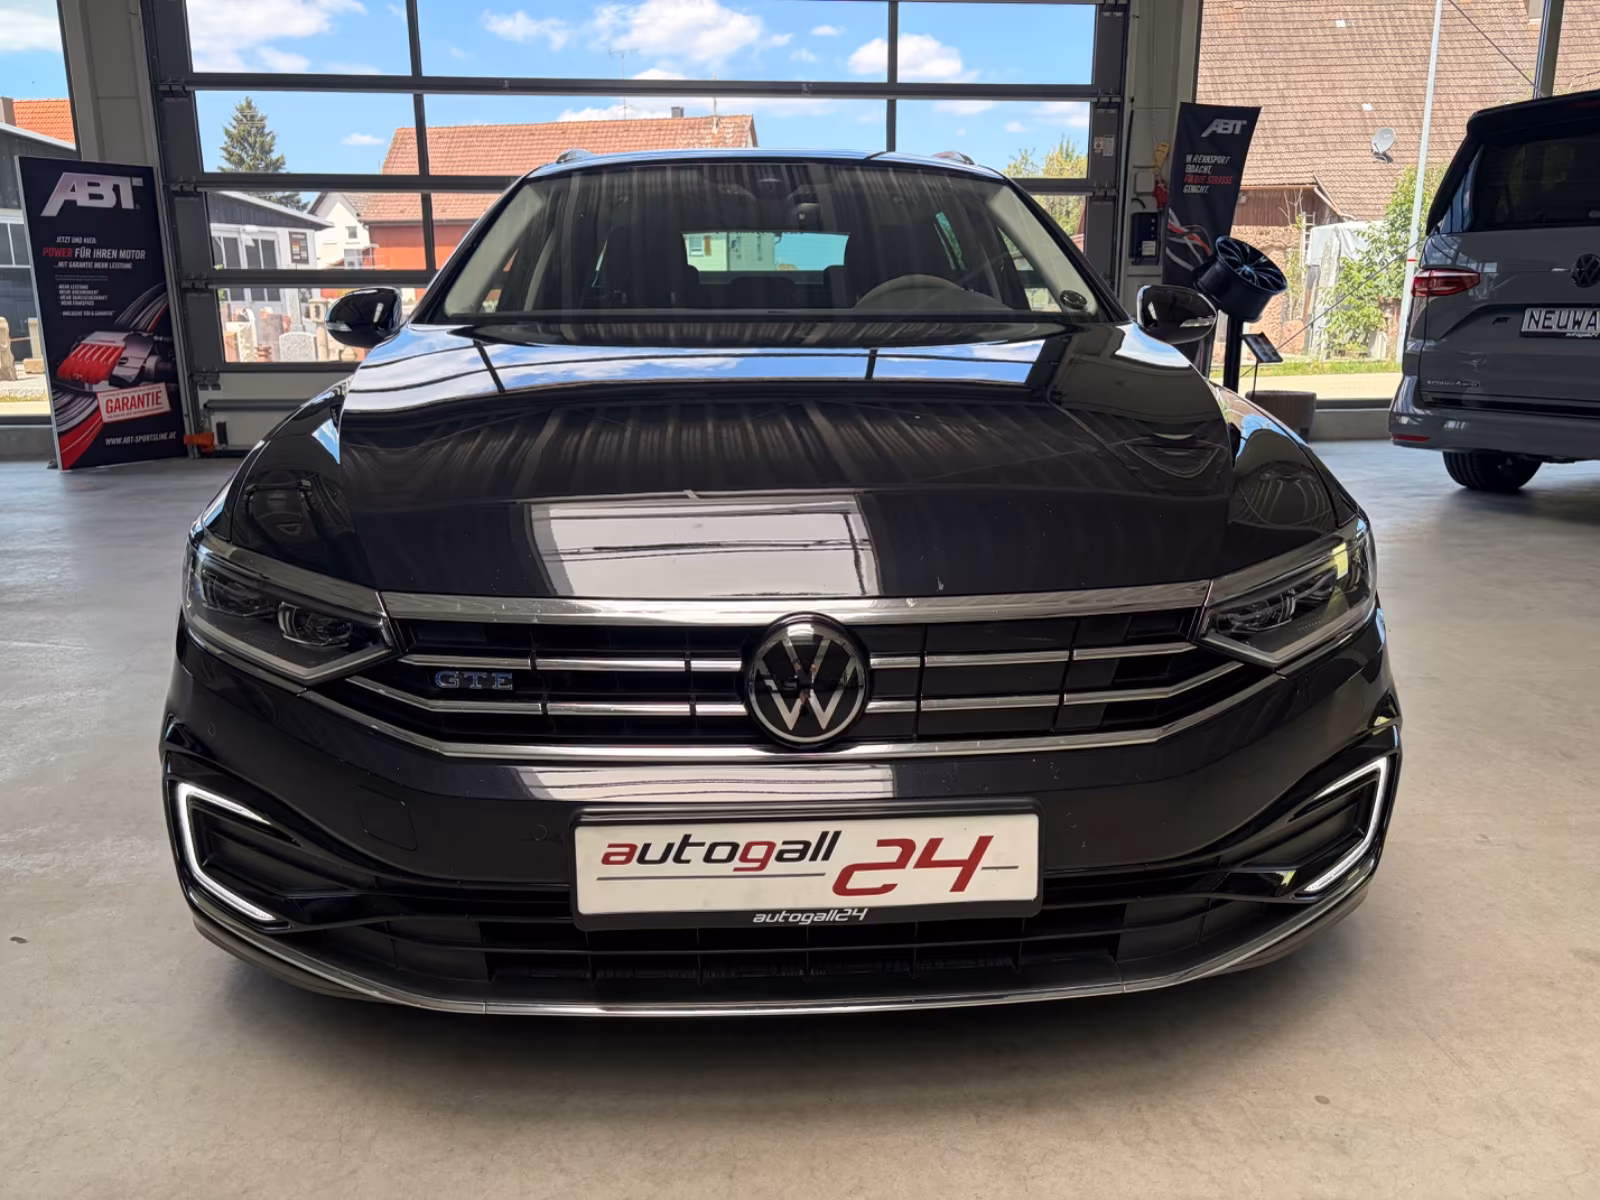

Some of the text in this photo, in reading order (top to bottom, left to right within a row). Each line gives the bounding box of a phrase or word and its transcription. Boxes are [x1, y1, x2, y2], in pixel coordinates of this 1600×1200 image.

[1201, 118, 1248, 138] ABT
[40, 171, 144, 217] ABT
[56, 236, 71, 244] JETZT
[71, 236, 83, 244] UND
[42, 246, 146, 260] POWER FÜR IHREN MOTOR
[106, 390, 163, 415] GARANTIE
[435, 670, 513, 690] GTE
[752, 908, 869, 925] autogall24
